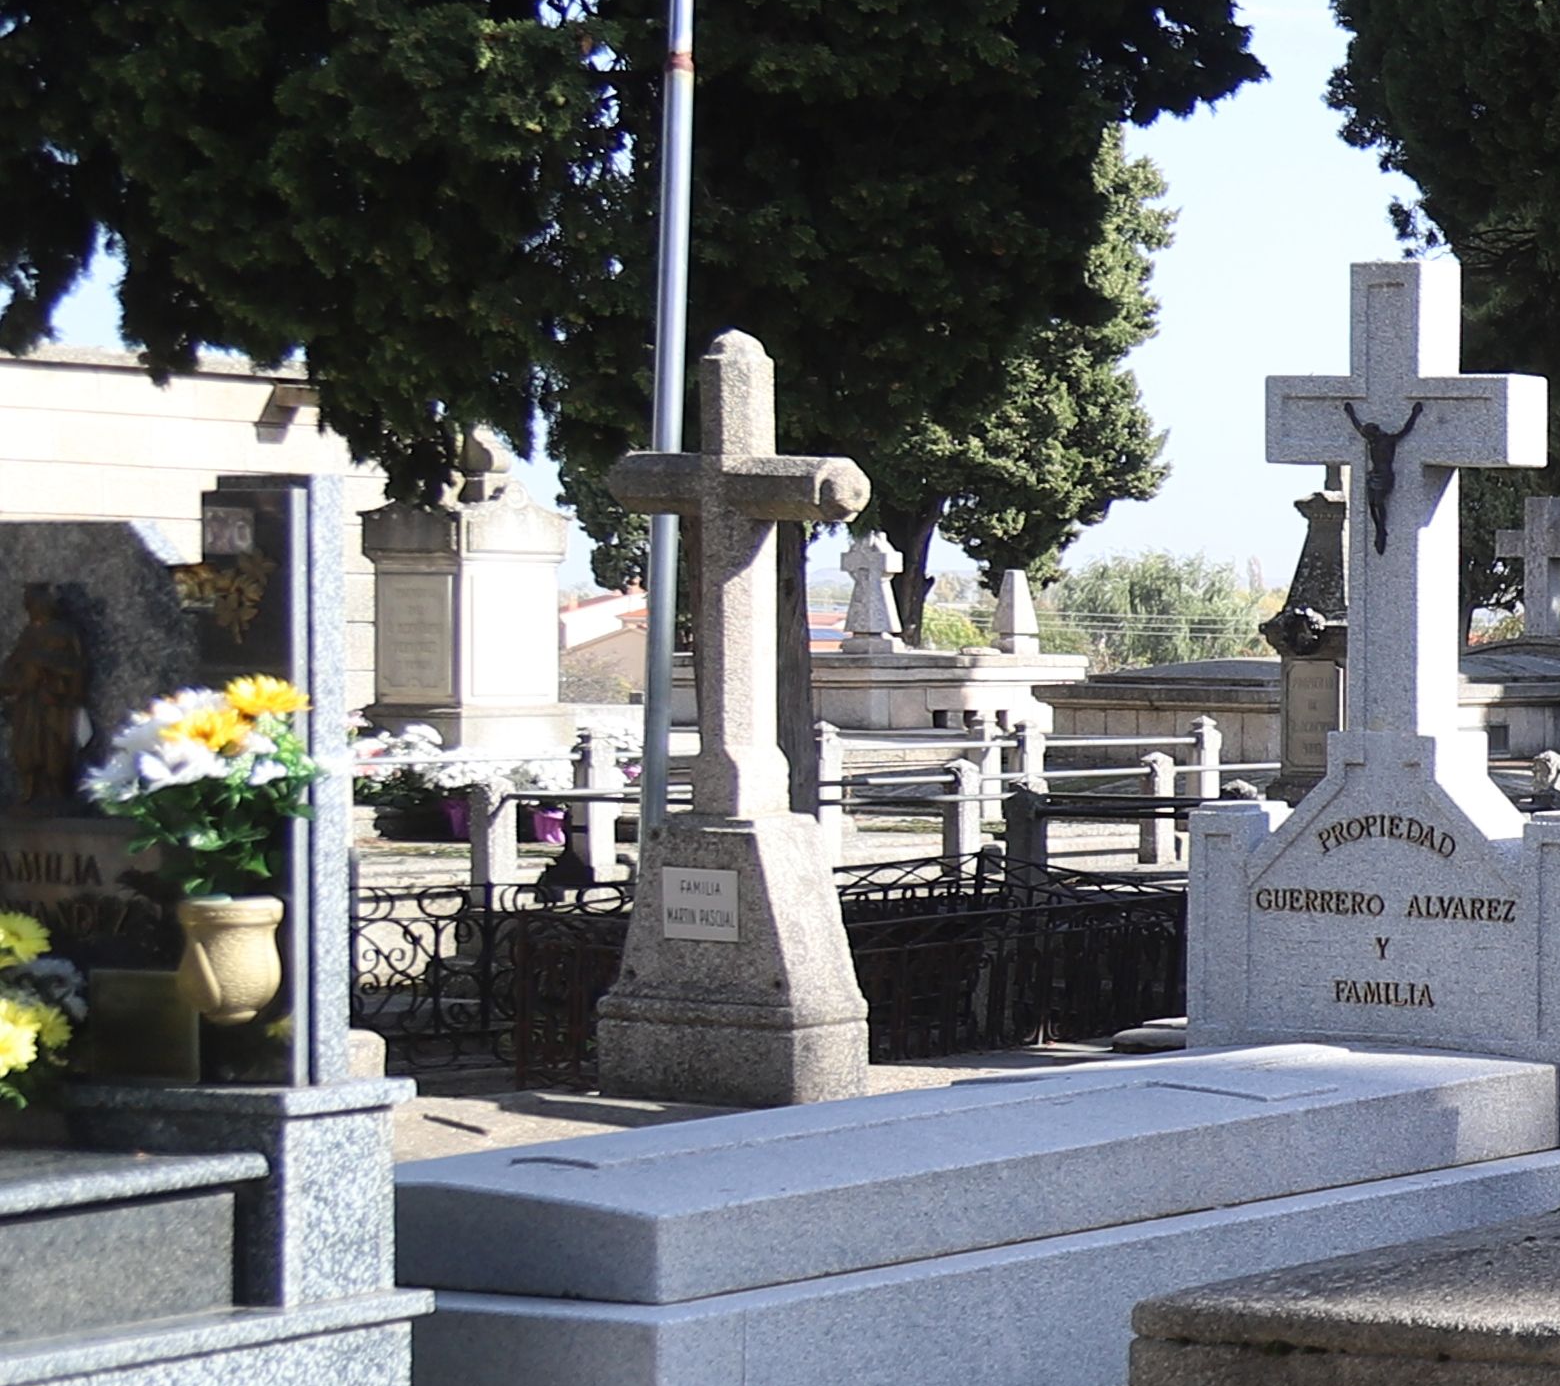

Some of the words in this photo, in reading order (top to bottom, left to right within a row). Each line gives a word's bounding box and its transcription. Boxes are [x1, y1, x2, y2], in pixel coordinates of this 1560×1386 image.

[1317, 813, 1457, 859] PROPIEDAD
[0, 851, 103, 886] AMILIA
[680, 879, 722, 896] FAMILIA
[667, 907, 697, 926] MARTIN
[699, 908, 736, 929] PASCUAL
[1256, 888, 1387, 917] GUERRERO
[1405, 894, 1518, 924] ALVAREZ
[1375, 936, 1390, 960] Y
[1333, 980, 1436, 1009] FAMILIA
